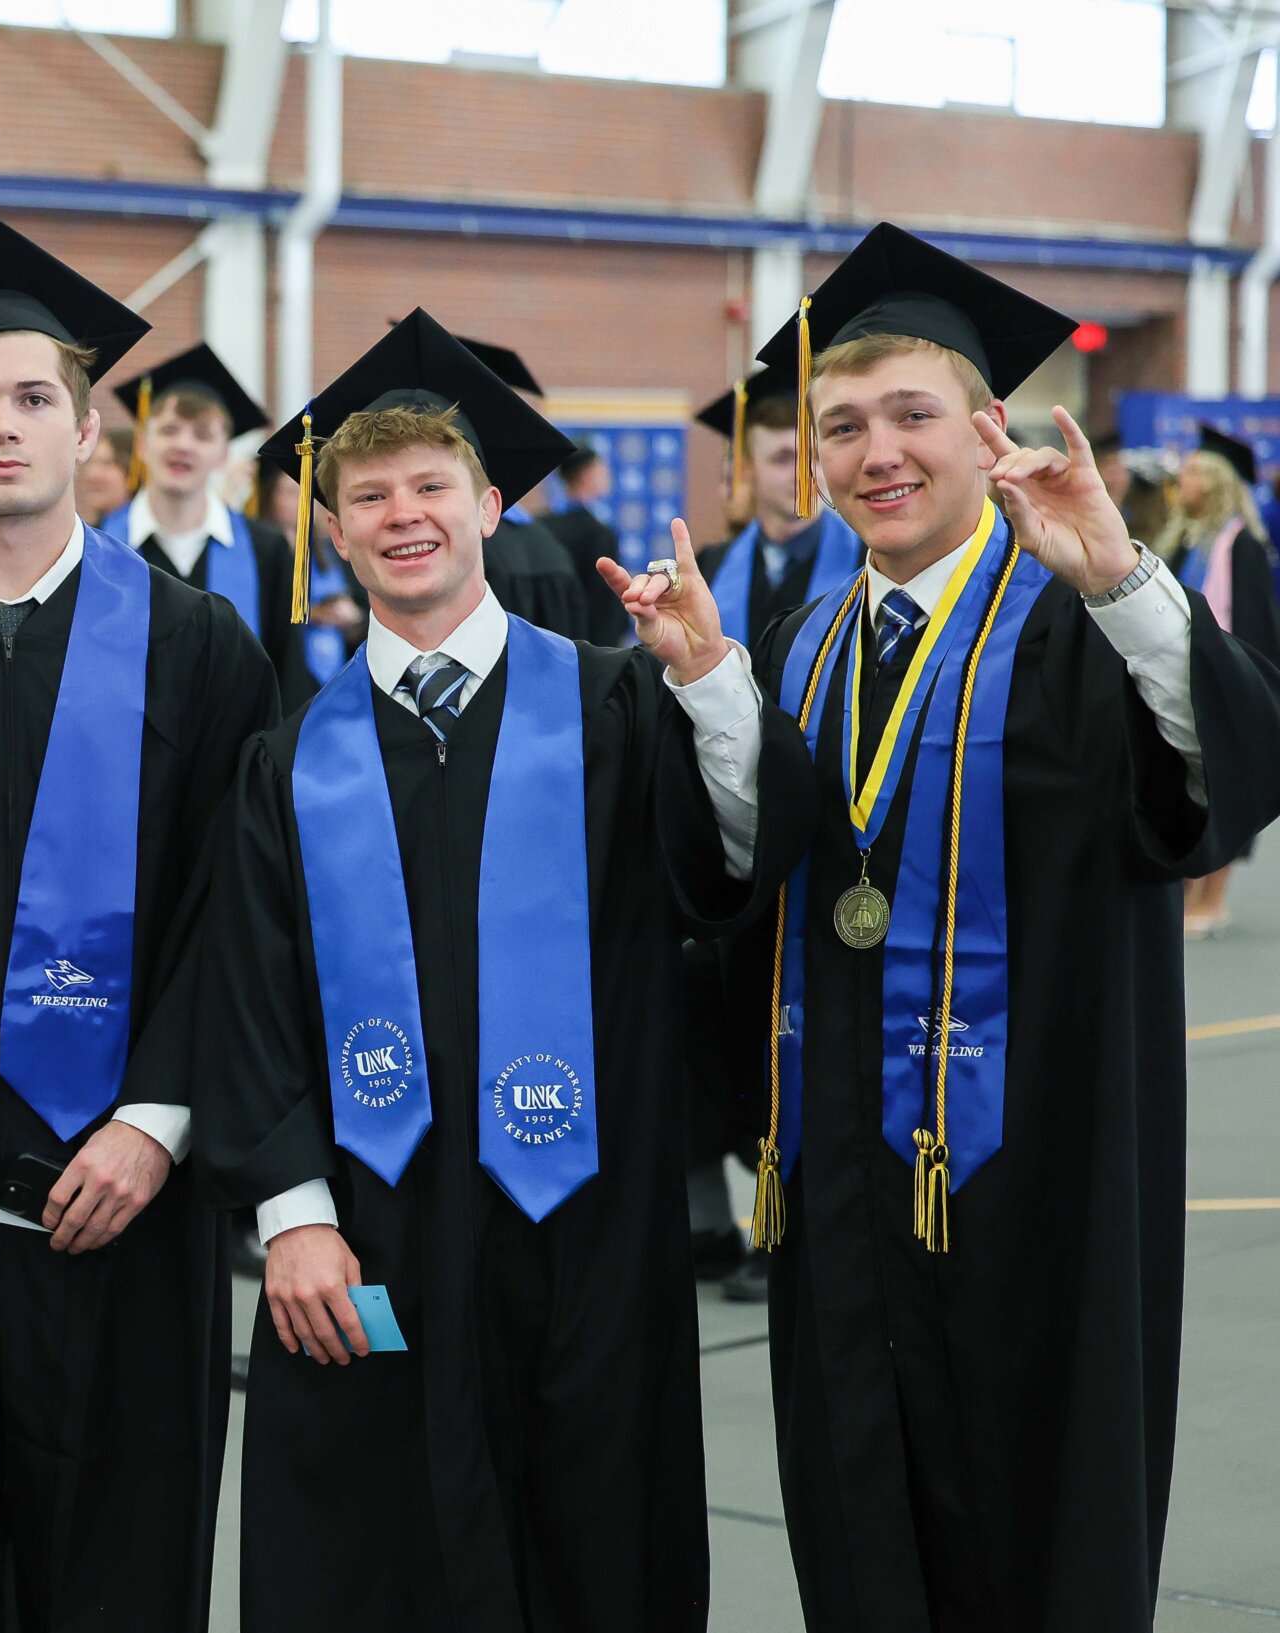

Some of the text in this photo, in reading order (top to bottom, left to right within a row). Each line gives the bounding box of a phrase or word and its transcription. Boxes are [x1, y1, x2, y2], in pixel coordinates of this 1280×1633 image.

[31, 995, 108, 1008] WRESTLING
[341, 1018, 413, 1088] UNIVERSITY OF NEBRASKA
[907, 1044, 984, 1058] WRSLING
[368, 1076, 392, 1089] 1905
[493, 1053, 583, 1118] UNIVERSITY OF NEBRASKA
[353, 1080, 409, 1108] KEARNEY
[524, 1115, 554, 1124] 1905
[504, 1121, 573, 1144] KEARNEY
